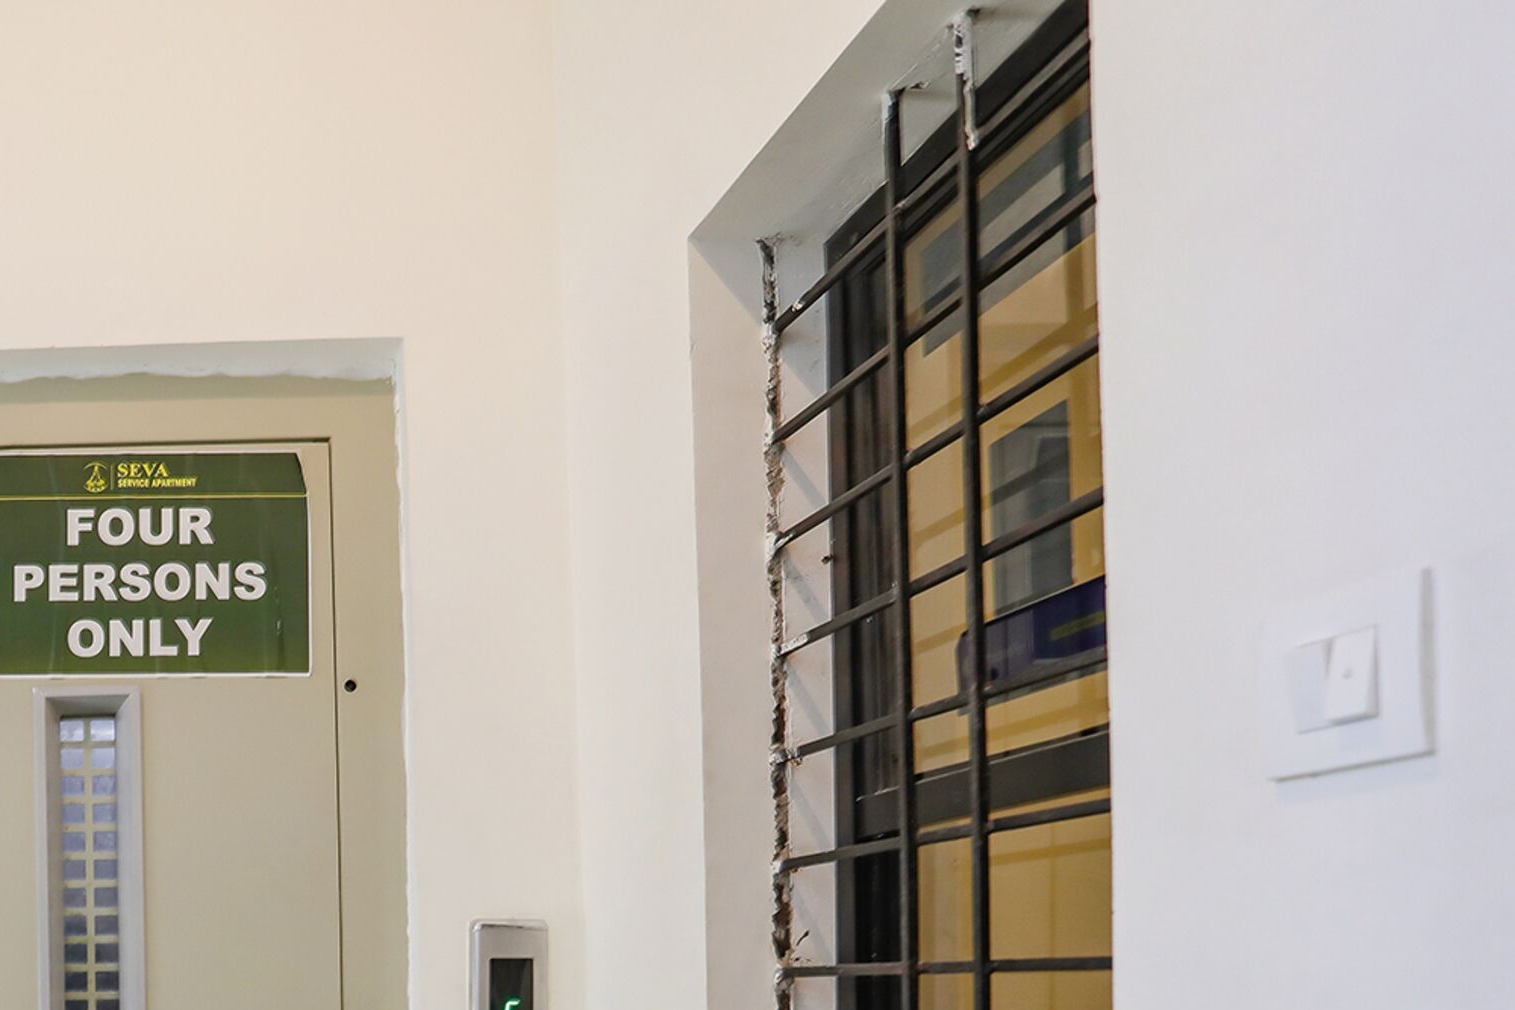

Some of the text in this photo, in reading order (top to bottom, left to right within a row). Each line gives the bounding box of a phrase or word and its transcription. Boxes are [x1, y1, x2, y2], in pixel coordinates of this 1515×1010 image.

[117, 462, 169, 478] SEVA
[117, 476, 198, 488] SERVICE APARTMENT
[66, 507, 215, 546] FOUR
[13, 561, 267, 602] PERSONS
[67, 617, 213, 658] ONLY
